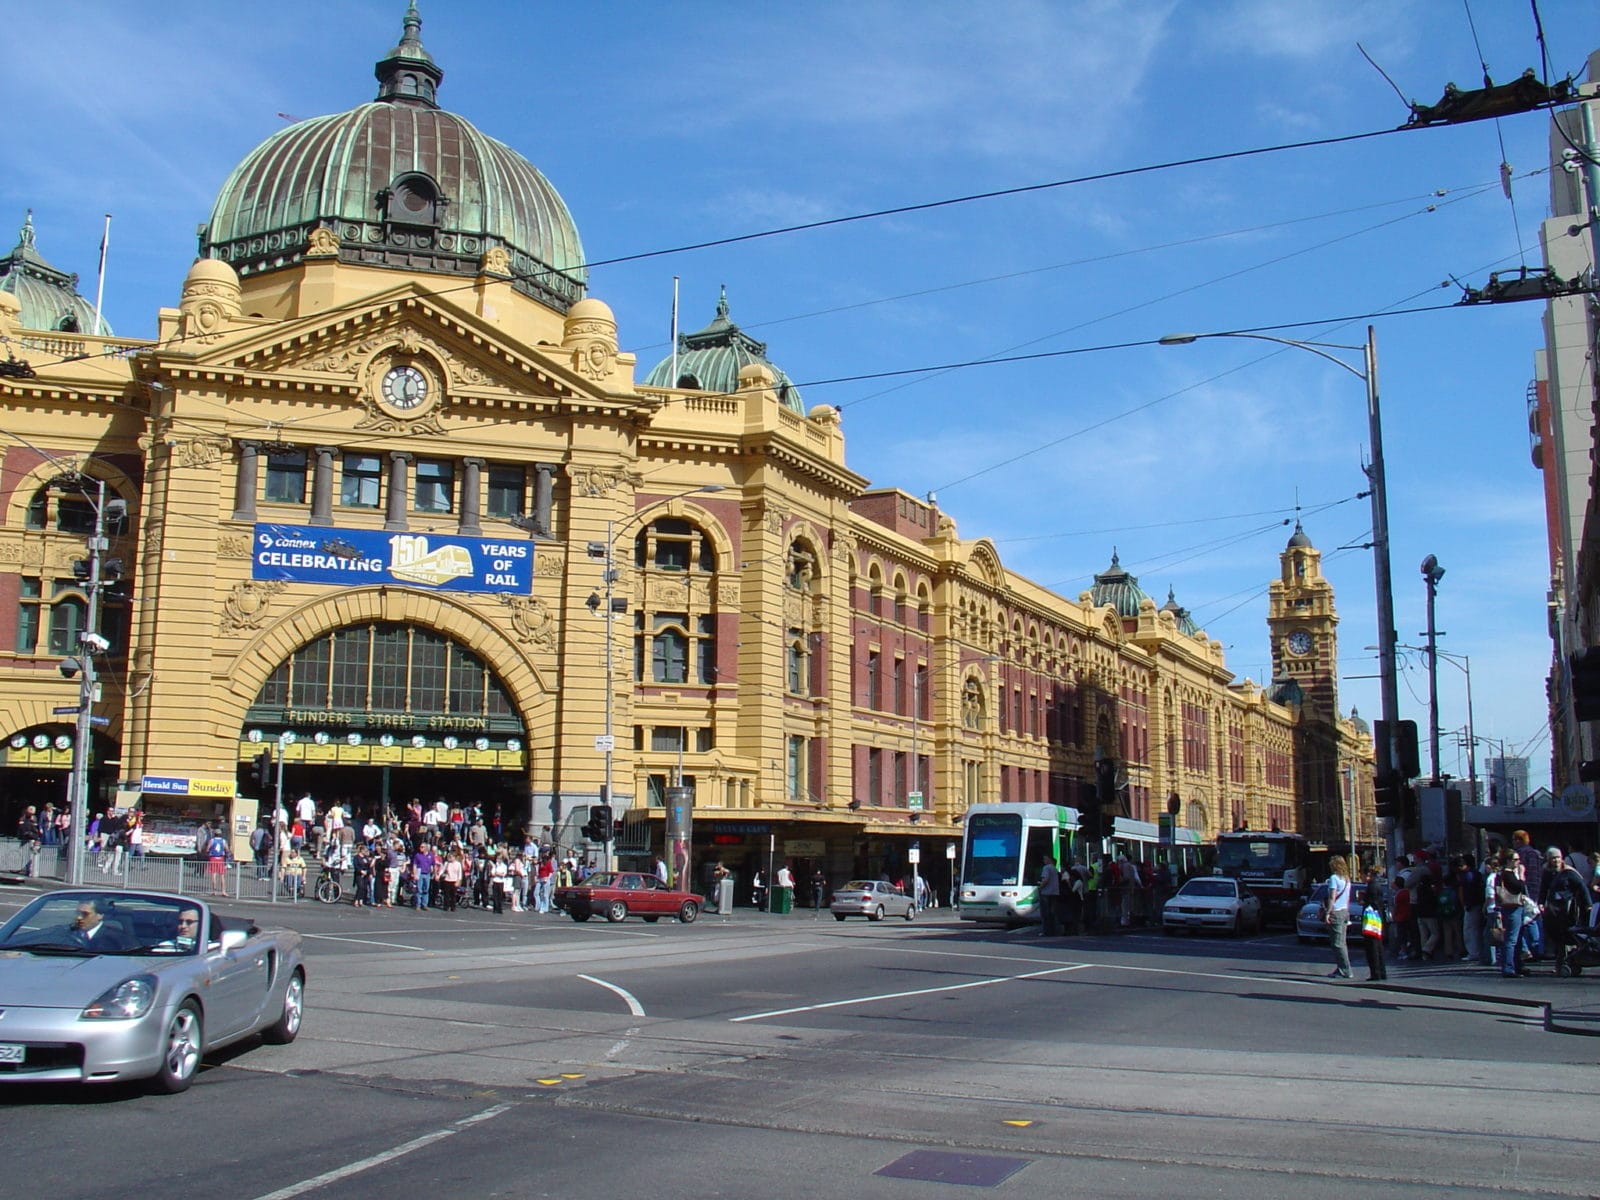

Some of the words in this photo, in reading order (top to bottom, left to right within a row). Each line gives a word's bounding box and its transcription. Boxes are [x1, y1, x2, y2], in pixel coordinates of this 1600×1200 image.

[275, 539, 317, 549] connex
[388, 534, 429, 567] 150
[481, 544, 527, 558] YEARS
[258, 552, 383, 572] CELEBRATING
[493, 560, 513, 571] OF
[485, 573, 519, 586] RAIL
[289, 710, 352, 723] FLINDERS
[367, 713, 415, 726] STREET
[430, 716, 486, 728] STATION
[143, 781, 170, 790] Herald
[172, 782, 188, 790] Sun
[192, 782, 231, 793] Sunday
